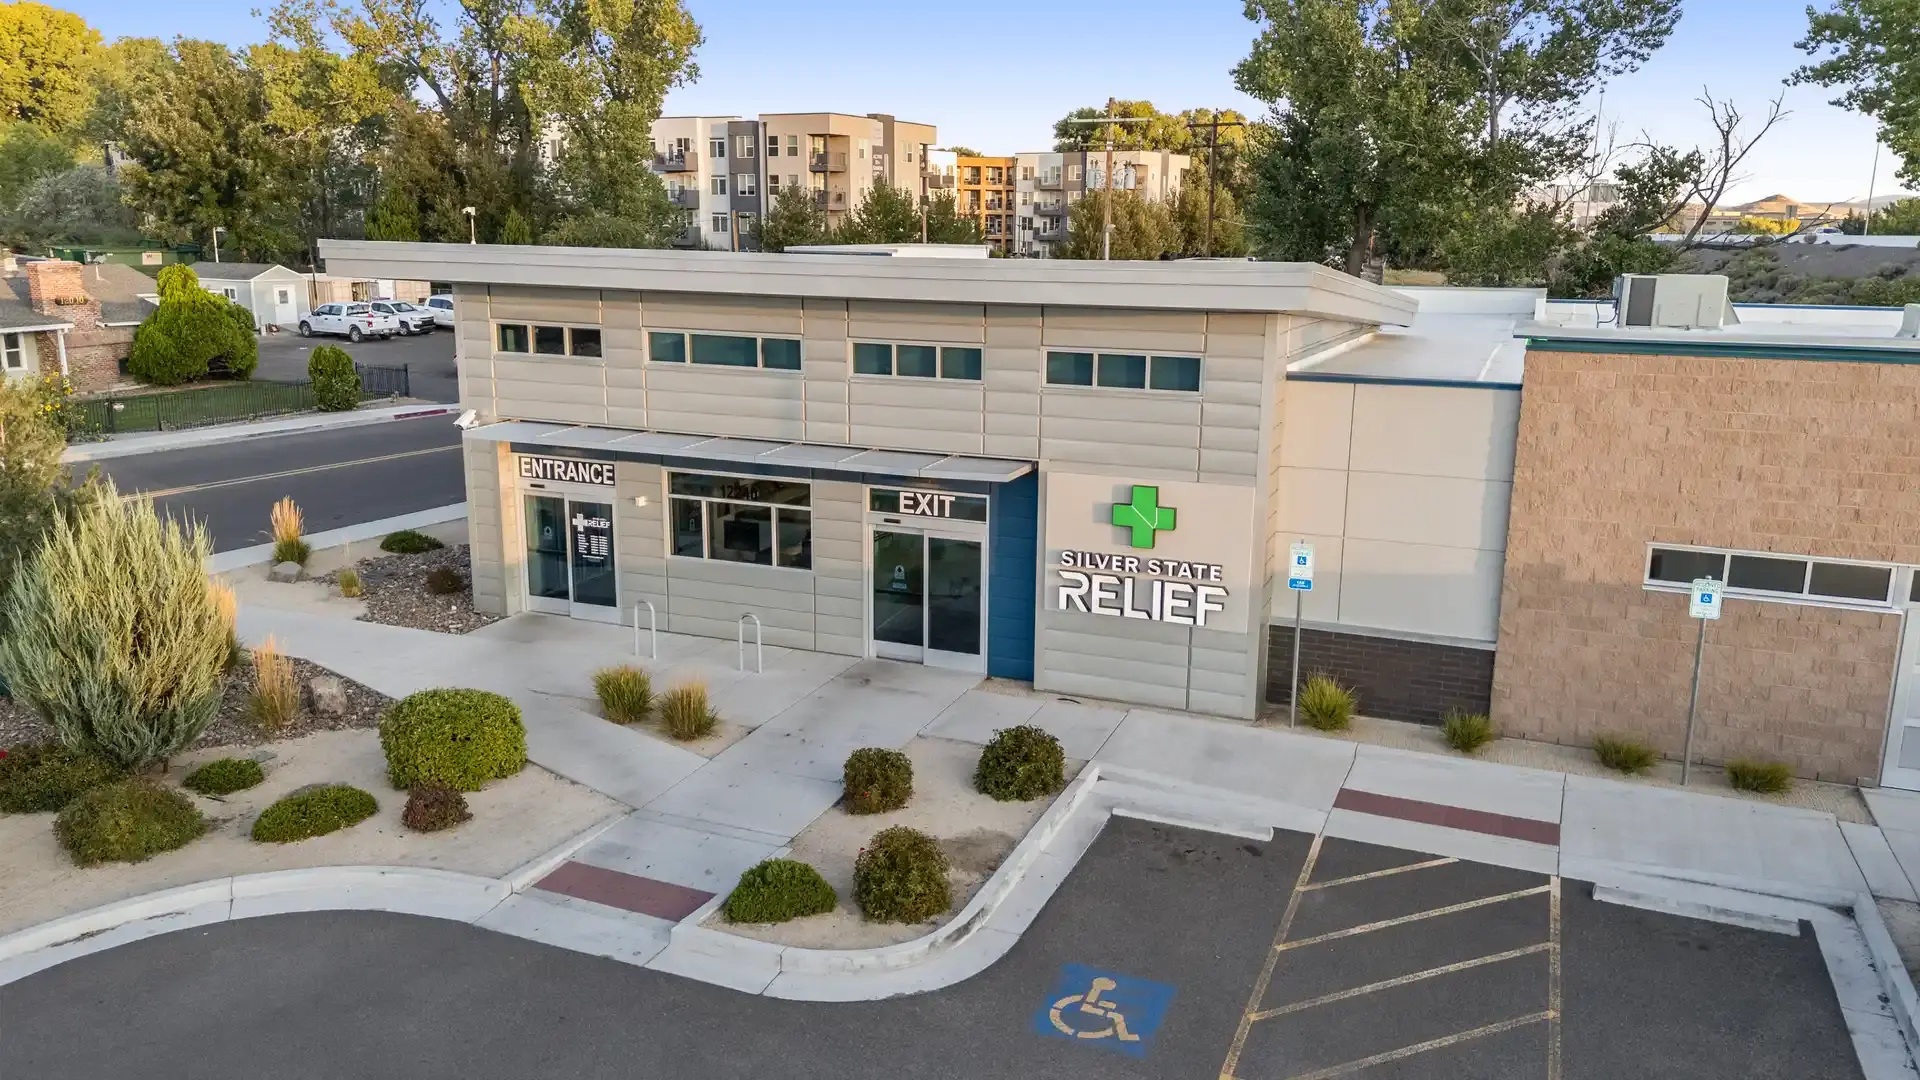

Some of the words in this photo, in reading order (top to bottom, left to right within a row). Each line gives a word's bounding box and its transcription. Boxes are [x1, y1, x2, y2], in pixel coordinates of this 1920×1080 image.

[520, 458, 614, 484] ENTRANCE
[900, 492, 955, 517] EXIT
[587, 519, 610, 529] RELIEF
[1061, 551, 1138, 573] SILVER
[1147, 559, 1221, 581] STATE
[1058, 570, 1229, 627] RELIEF
